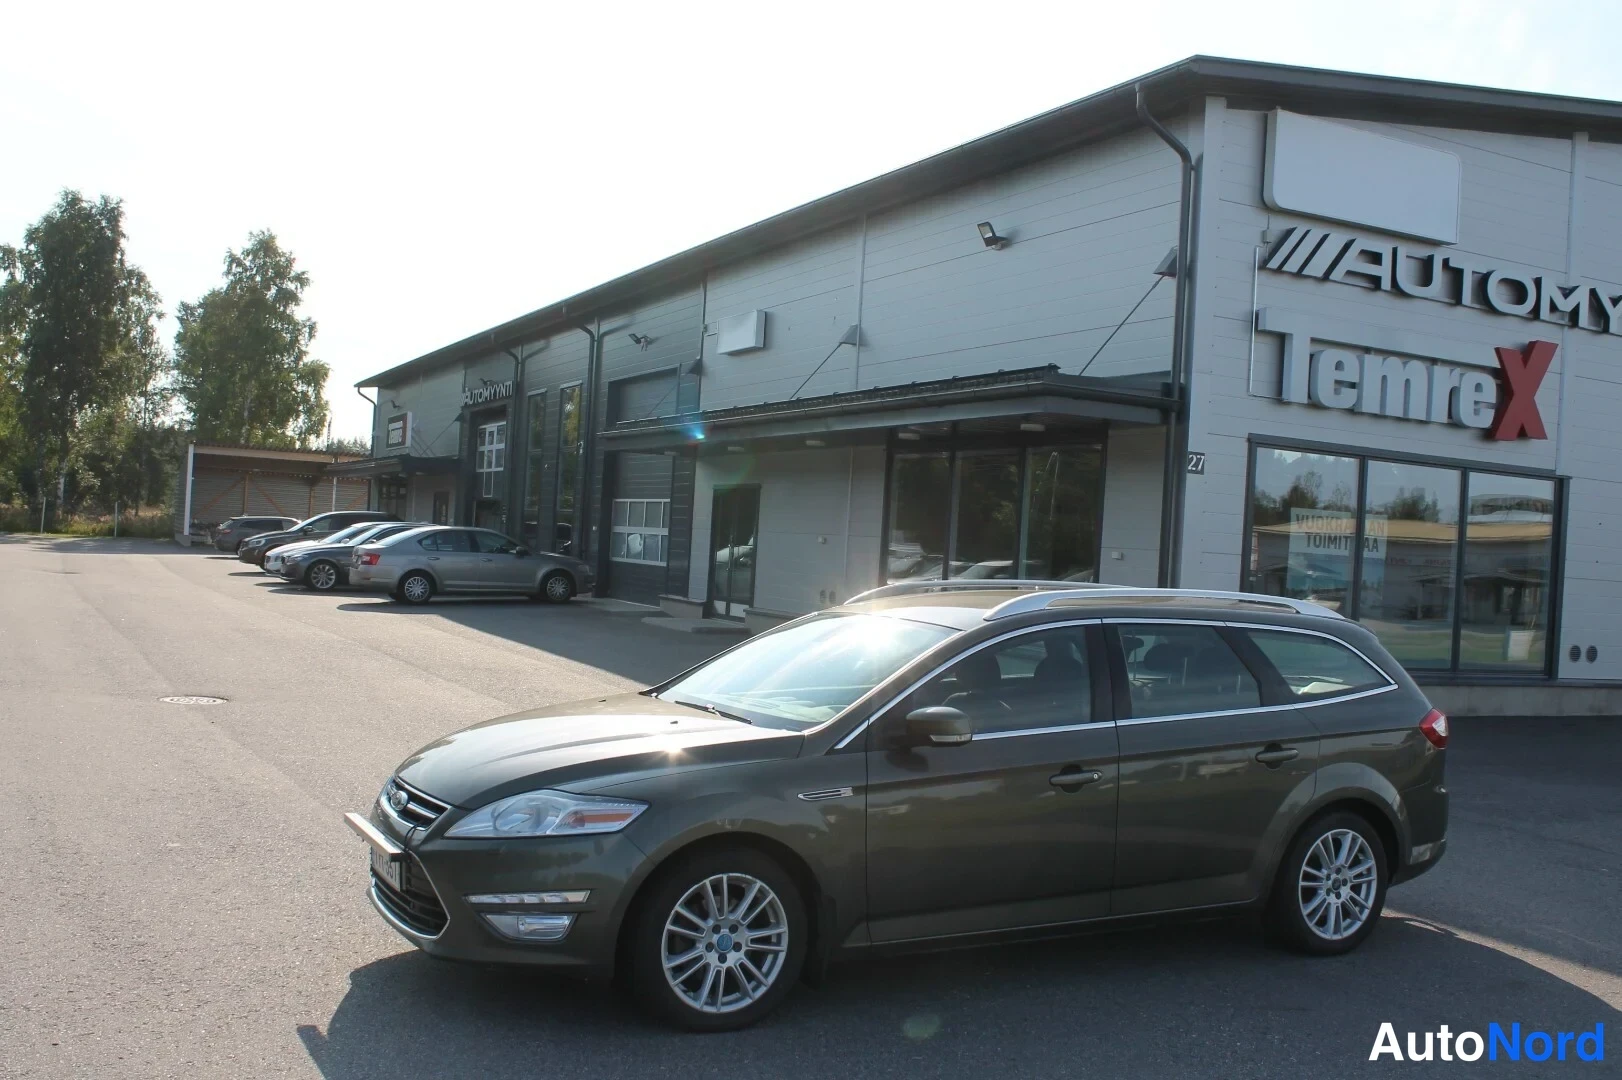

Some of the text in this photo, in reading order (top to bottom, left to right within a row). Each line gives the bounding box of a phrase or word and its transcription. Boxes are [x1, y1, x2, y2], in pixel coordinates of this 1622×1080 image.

[1257, 306, 1560, 442] TemreX
[463, 380, 513, 406] AUTOMYYNTI
[1187, 454, 1205, 472] 27
[1295, 513, 1385, 536] VUOKRAAN
[1305, 532, 1379, 553] TOIMITAA
